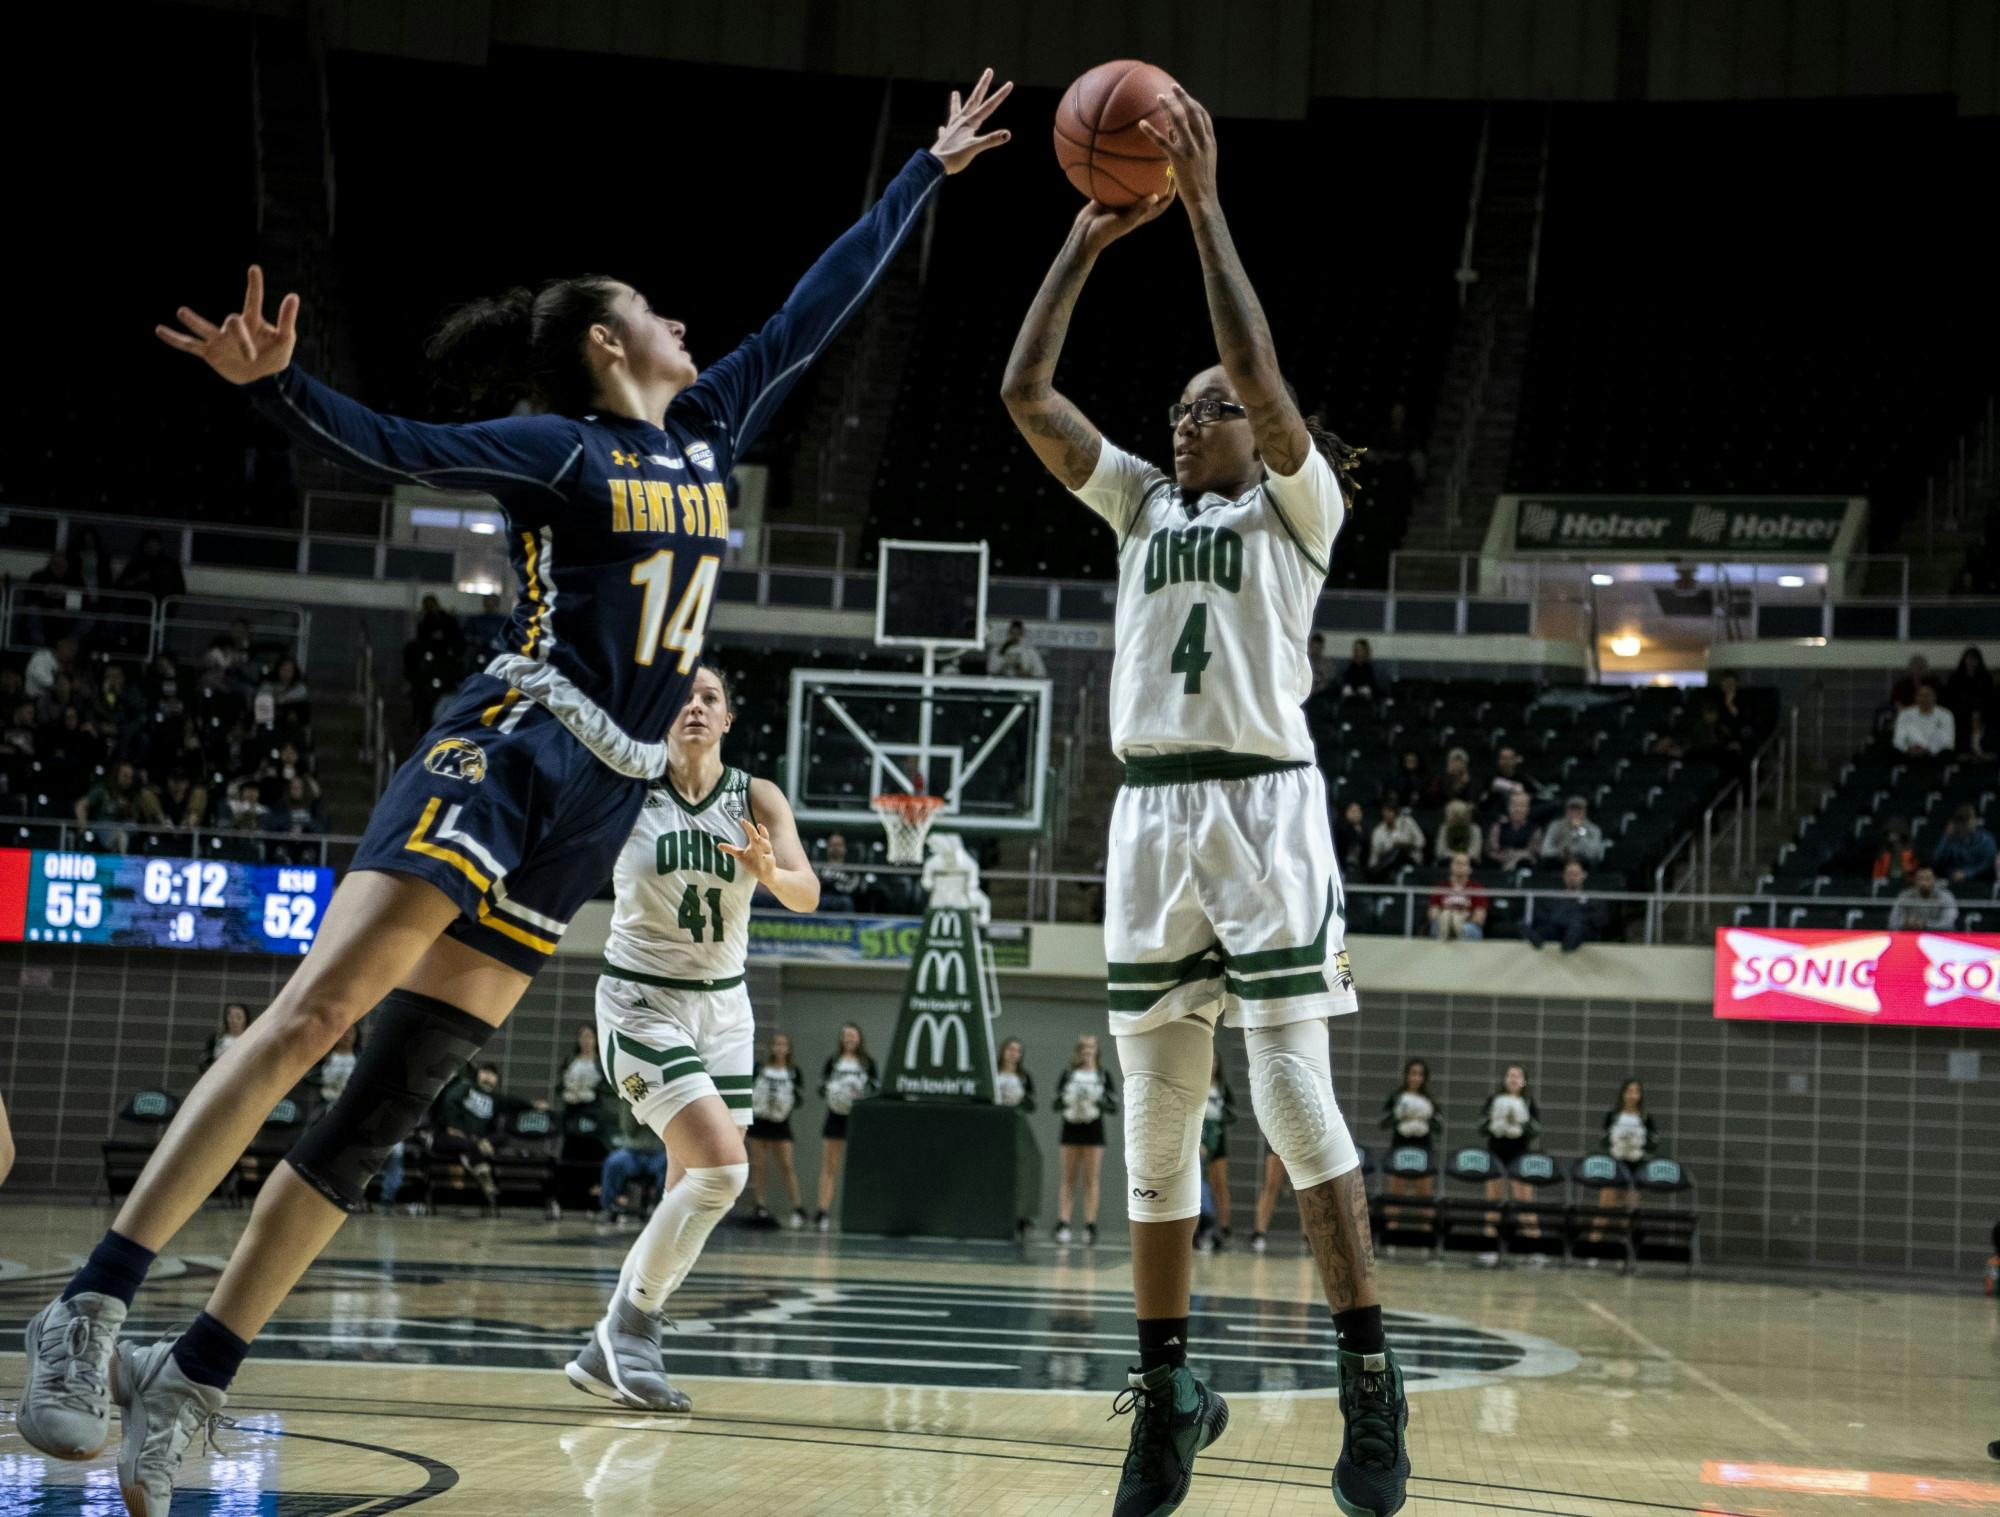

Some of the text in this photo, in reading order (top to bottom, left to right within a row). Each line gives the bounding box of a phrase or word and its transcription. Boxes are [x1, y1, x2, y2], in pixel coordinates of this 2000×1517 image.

[607, 479, 729, 541] KENT STAT
[1561, 512, 1672, 539] Holzer
[1143, 526, 1243, 595] OHIO
[630, 549, 720, 675] 14
[1170, 602, 1213, 695] 4
[44, 852, 97, 881] OHIO
[656, 828, 736, 883] OHIO
[45, 881, 103, 928] 55
[143, 859, 229, 908] 6:12
[277, 868, 317, 893] KSU
[262, 893, 317, 940] 52
[678, 884, 725, 943] 41
[1735, 955, 1878, 988] SONIC
[1932, 960, 2000, 992] SO
